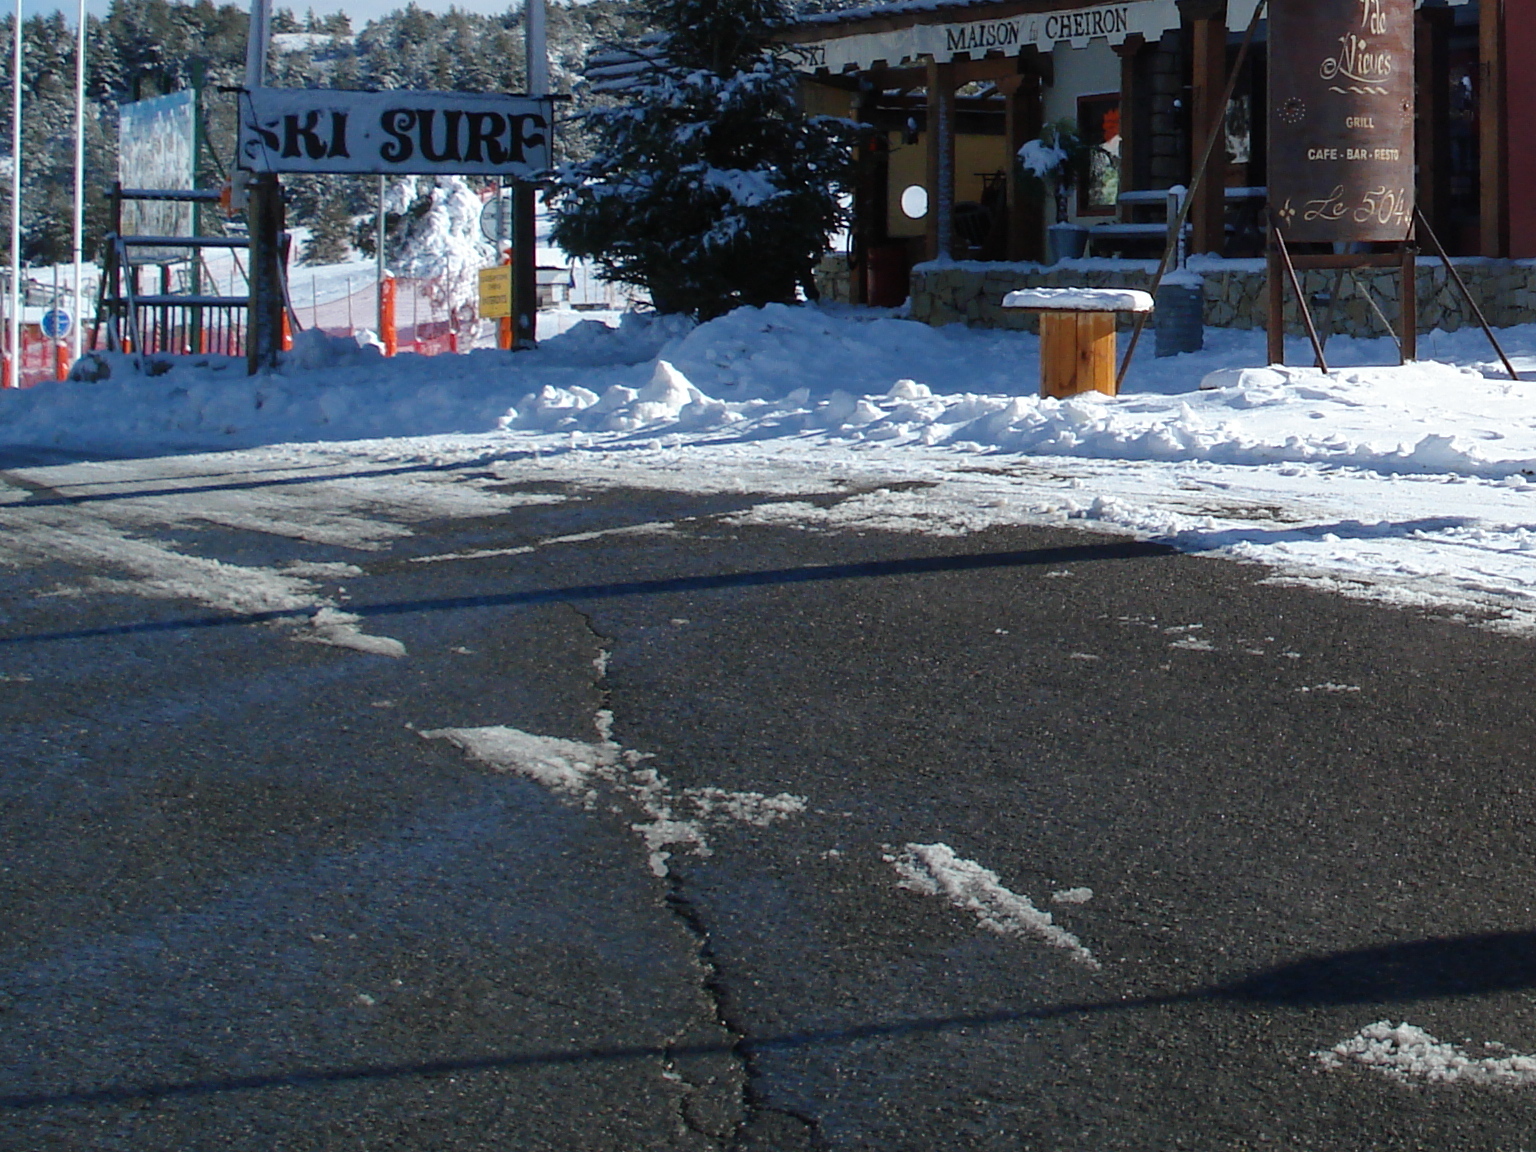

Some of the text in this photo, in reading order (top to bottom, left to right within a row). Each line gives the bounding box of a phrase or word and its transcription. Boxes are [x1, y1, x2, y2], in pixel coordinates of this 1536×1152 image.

[946, 21, 1020, 51] MAISON
[1045, 7, 1129, 40] CHEIRON
[1320, 32, 1392, 82] Nieves
[380, 108, 549, 165] SURF
[1346, 116, 1375, 129] GRILL
[1307, 148, 1400, 161] CAFE BAR RESTO
[1304, 184, 1405, 226] Le 504
